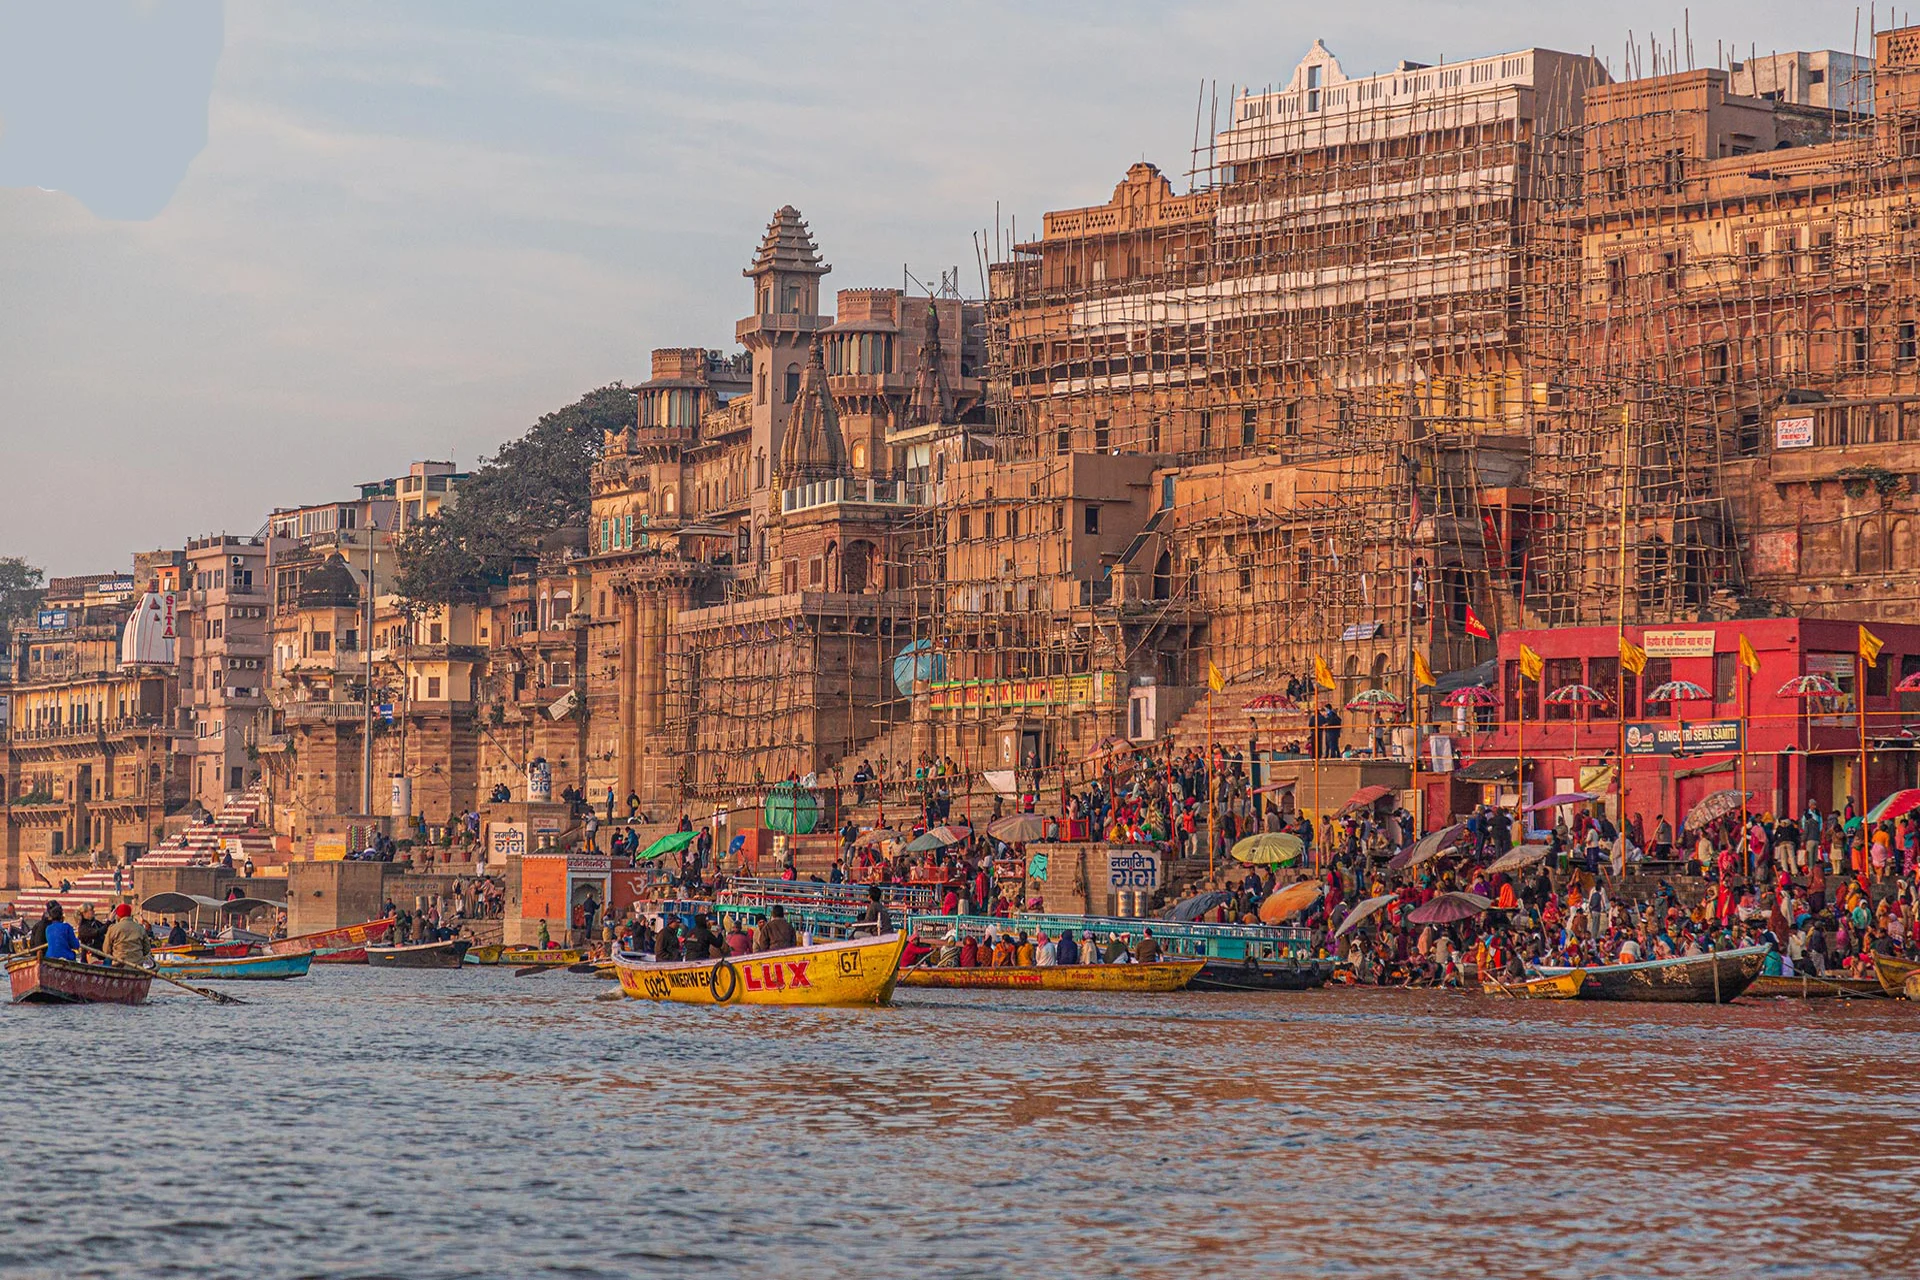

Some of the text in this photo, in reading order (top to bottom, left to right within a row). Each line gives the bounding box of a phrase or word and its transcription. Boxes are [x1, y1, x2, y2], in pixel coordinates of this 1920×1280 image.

[113, 581, 133, 591] SCHOOL
[165, 595, 174, 636] SITA
[1693, 728, 1712, 741] SEWA
[1713, 727, 1737, 740] SAMITI
[1111, 851, 1146, 867] नमामि
[840, 951, 859, 973] 67
[743, 960, 813, 991] LUX
